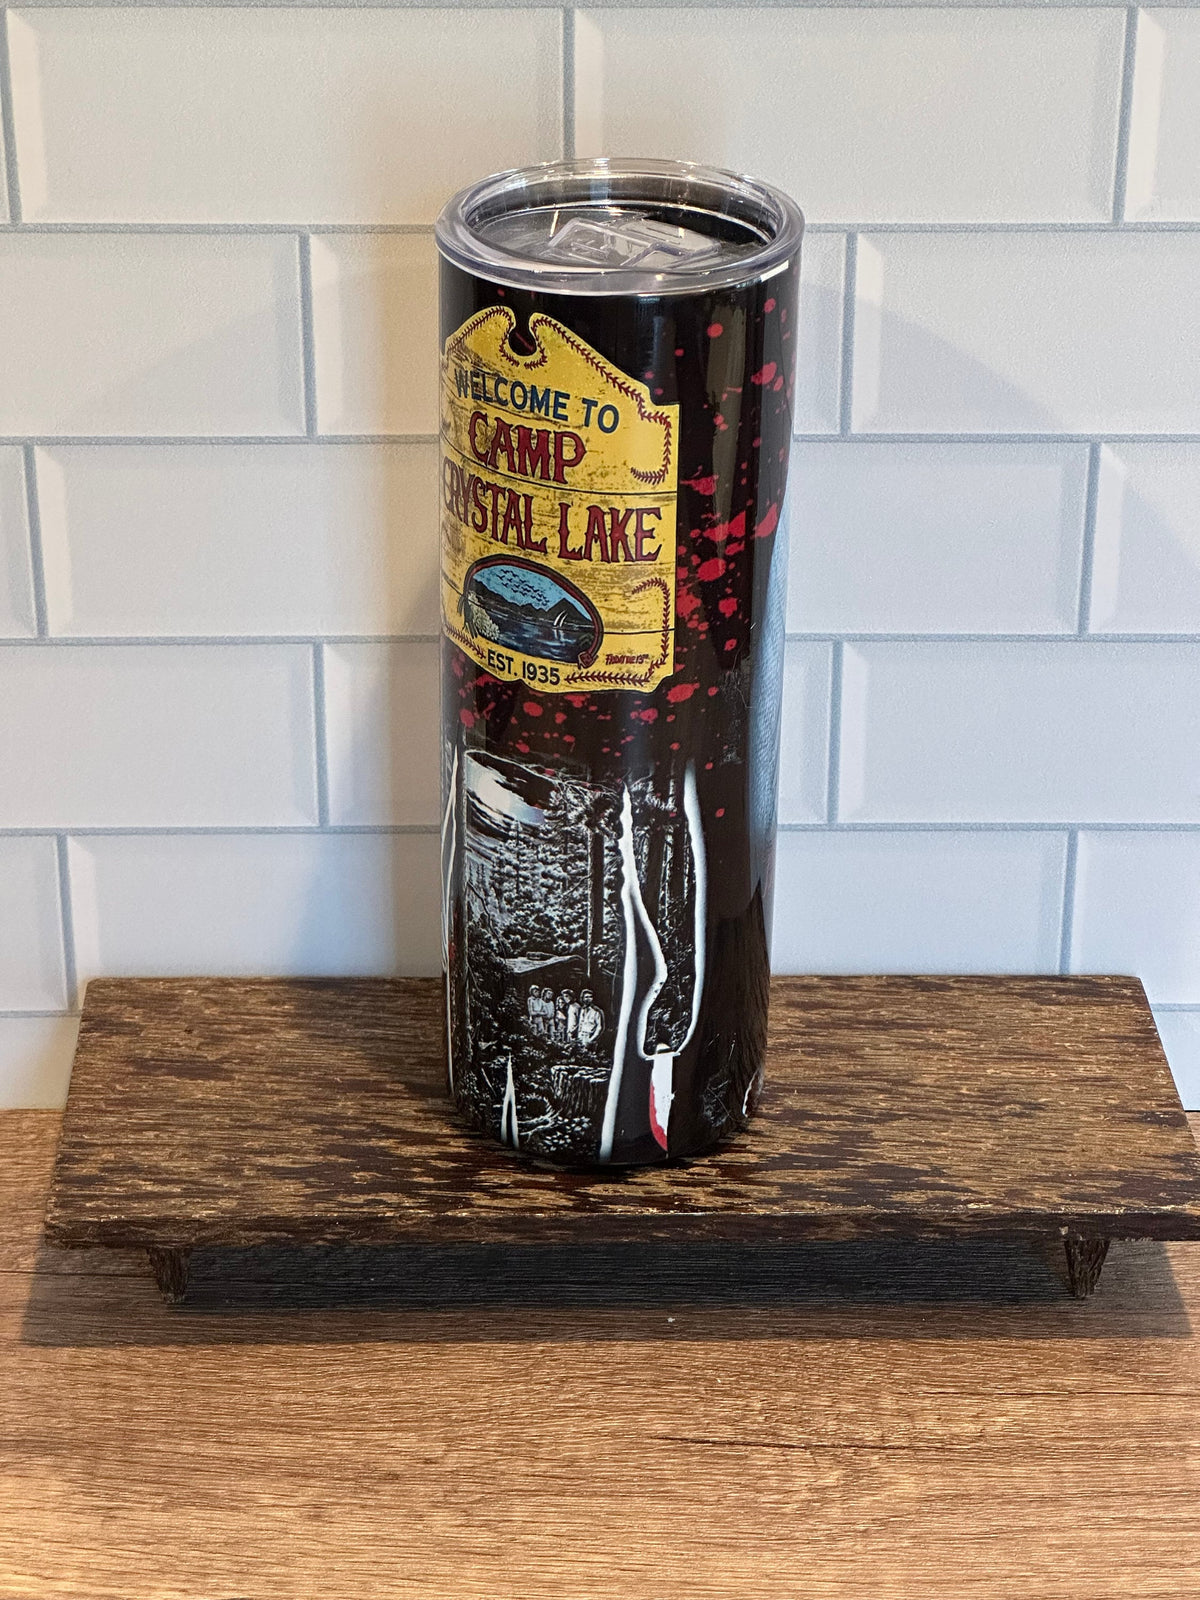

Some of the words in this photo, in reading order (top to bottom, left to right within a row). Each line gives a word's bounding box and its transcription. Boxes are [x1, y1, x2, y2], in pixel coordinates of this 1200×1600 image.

[453, 367, 571, 422] WELCOME
[582, 398, 620, 434] TO
[468, 411, 587, 484] CAMP
[443, 456, 547, 553] CRYSTAL
[557, 502, 663, 563] LAKE
[487, 649, 518, 677] EST.
[522, 660, 560, 686] 1935
